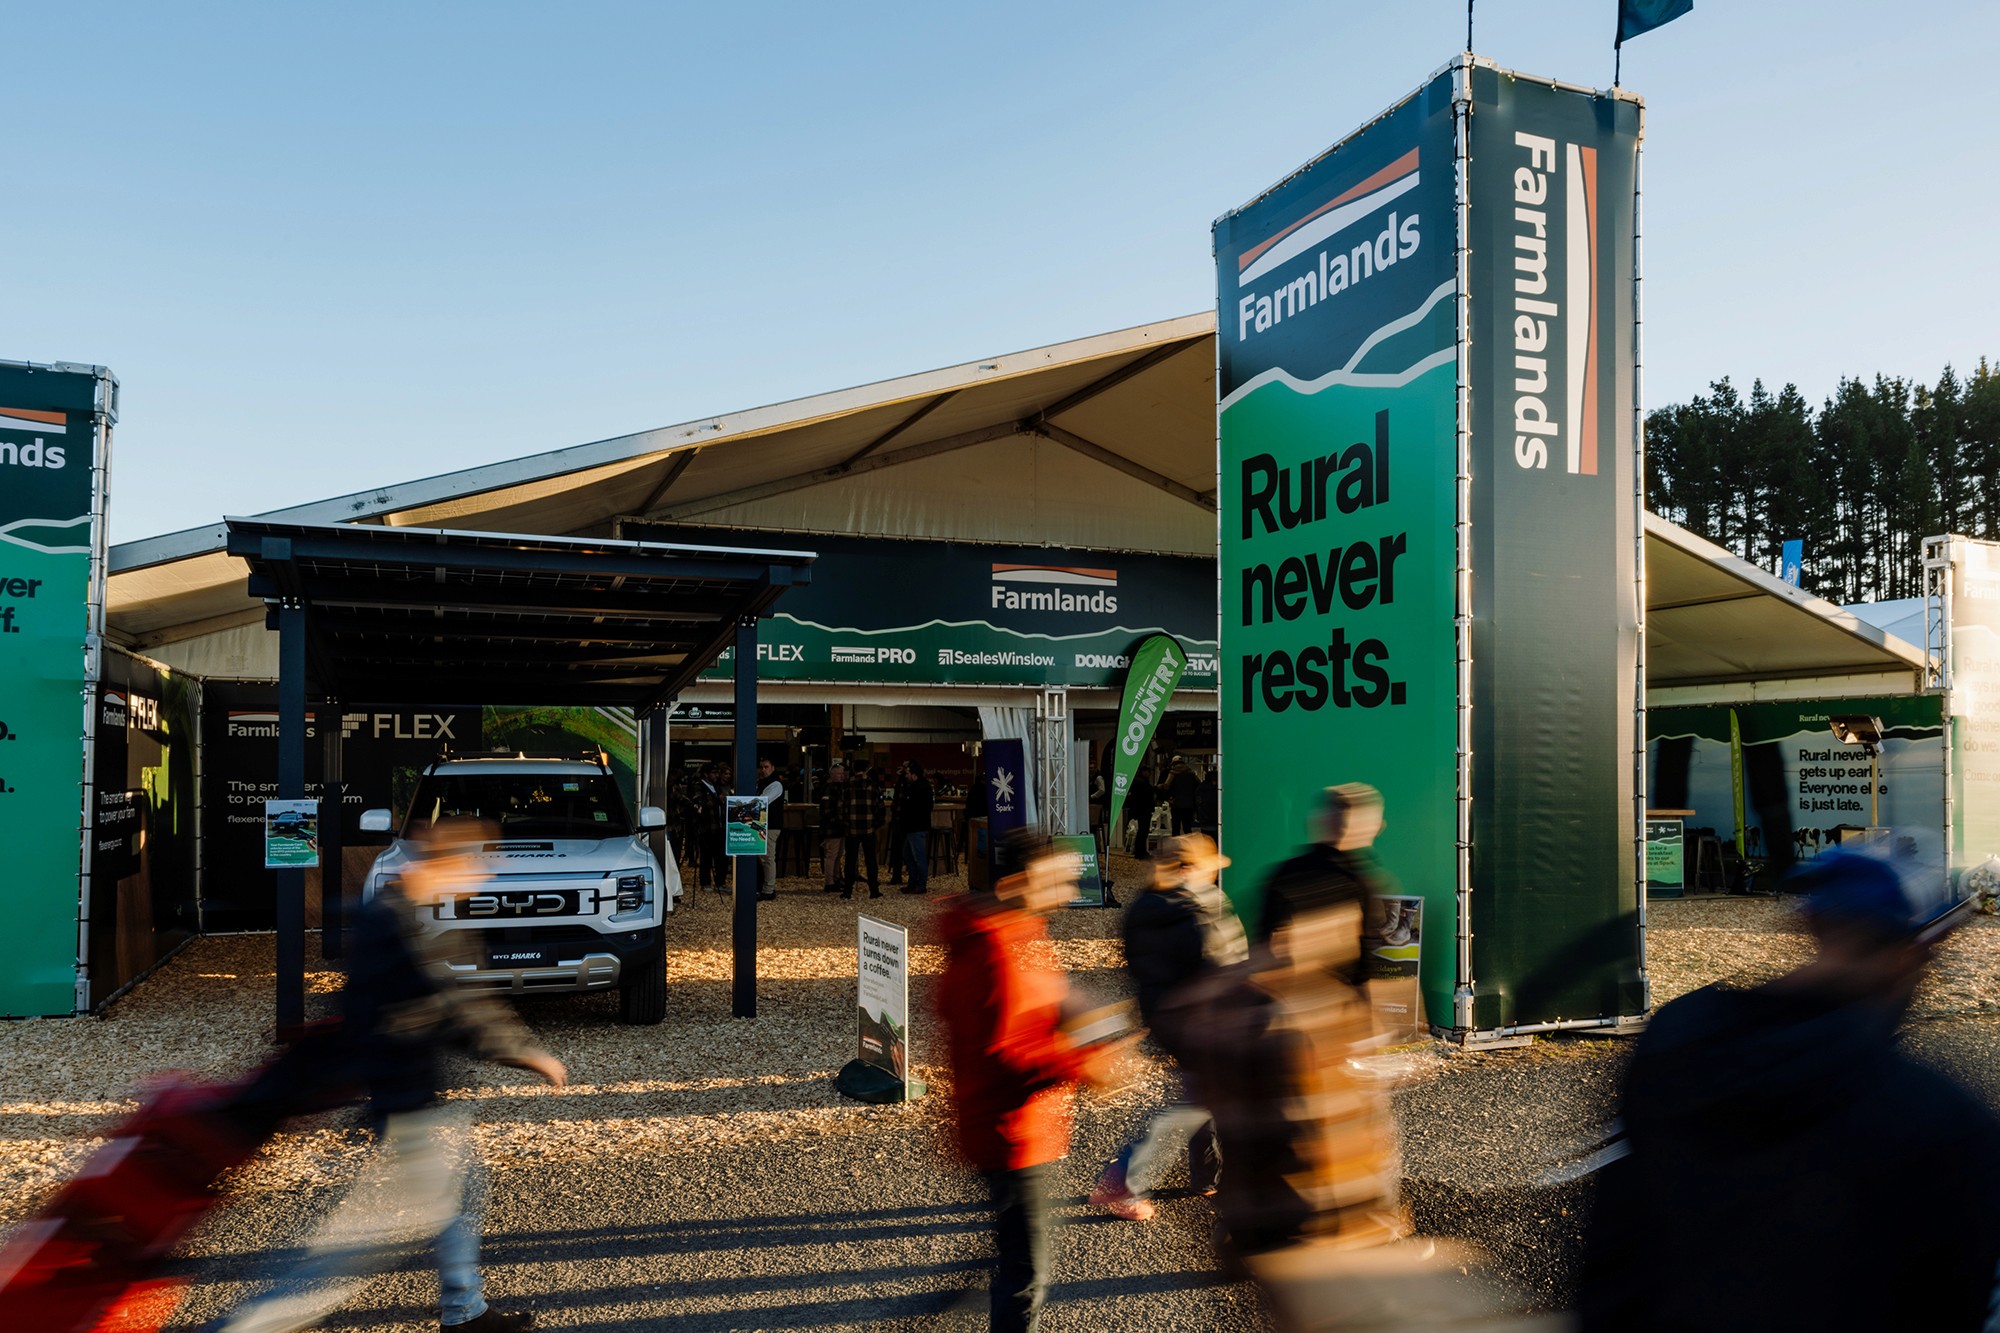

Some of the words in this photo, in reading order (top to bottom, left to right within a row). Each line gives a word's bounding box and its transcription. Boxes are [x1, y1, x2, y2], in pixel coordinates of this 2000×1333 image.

[1239, 211, 1421, 342] Farmlands
[1514, 131, 1558, 470] Farmlands
[1242, 409, 1390, 539] Rural
[1242, 531, 1406, 626] never
[992, 586, 1118, 614] Farmlands
[757, 644, 805, 661] FLEX
[831, 654, 875, 663] Farmlands
[878, 648, 917, 664] PRO
[955, 651, 1056, 666] SealesWinslow.
[1242, 627, 1406, 713] rests.
[1122, 648, 1179, 756] COUNTRY
[1135, 687, 1145, 701] THE
[138, 696, 158, 731] FLEX
[1799, 714, 1818, 722] Rural
[374, 713, 456, 739] FLEX
[1963, 737, 1978, 752] do
[1981, 741, 1998, 752] we.
[1799, 749, 1830, 761] Rural
[1799, 766, 1827, 780] gets
[1829, 768, 1846, 781] up
[1848, 765, 1883, 778] earl.
[227, 781, 256, 792] The
[259, 782, 317, 792] smer
[1799, 781, 1858, 797] Everyone
[1860, 782, 1888, 795] ele
[227, 795, 243, 804] to
[1799, 797, 1811, 810] is
[1811, 797, 1834, 813] just
[1837, 798, 1864, 811] late.
[995, 803, 1012, 814] Spark
[469, 894, 566, 916] BYD
[863, 931, 880, 948] Rural
[881, 940, 899, 955] never
[510, 952, 536, 961] SHARK
[863, 946, 881, 961] turns
[882, 953, 899, 969] down
[863, 961, 868, 970] a
[869, 963, 891, 979] coffee.
